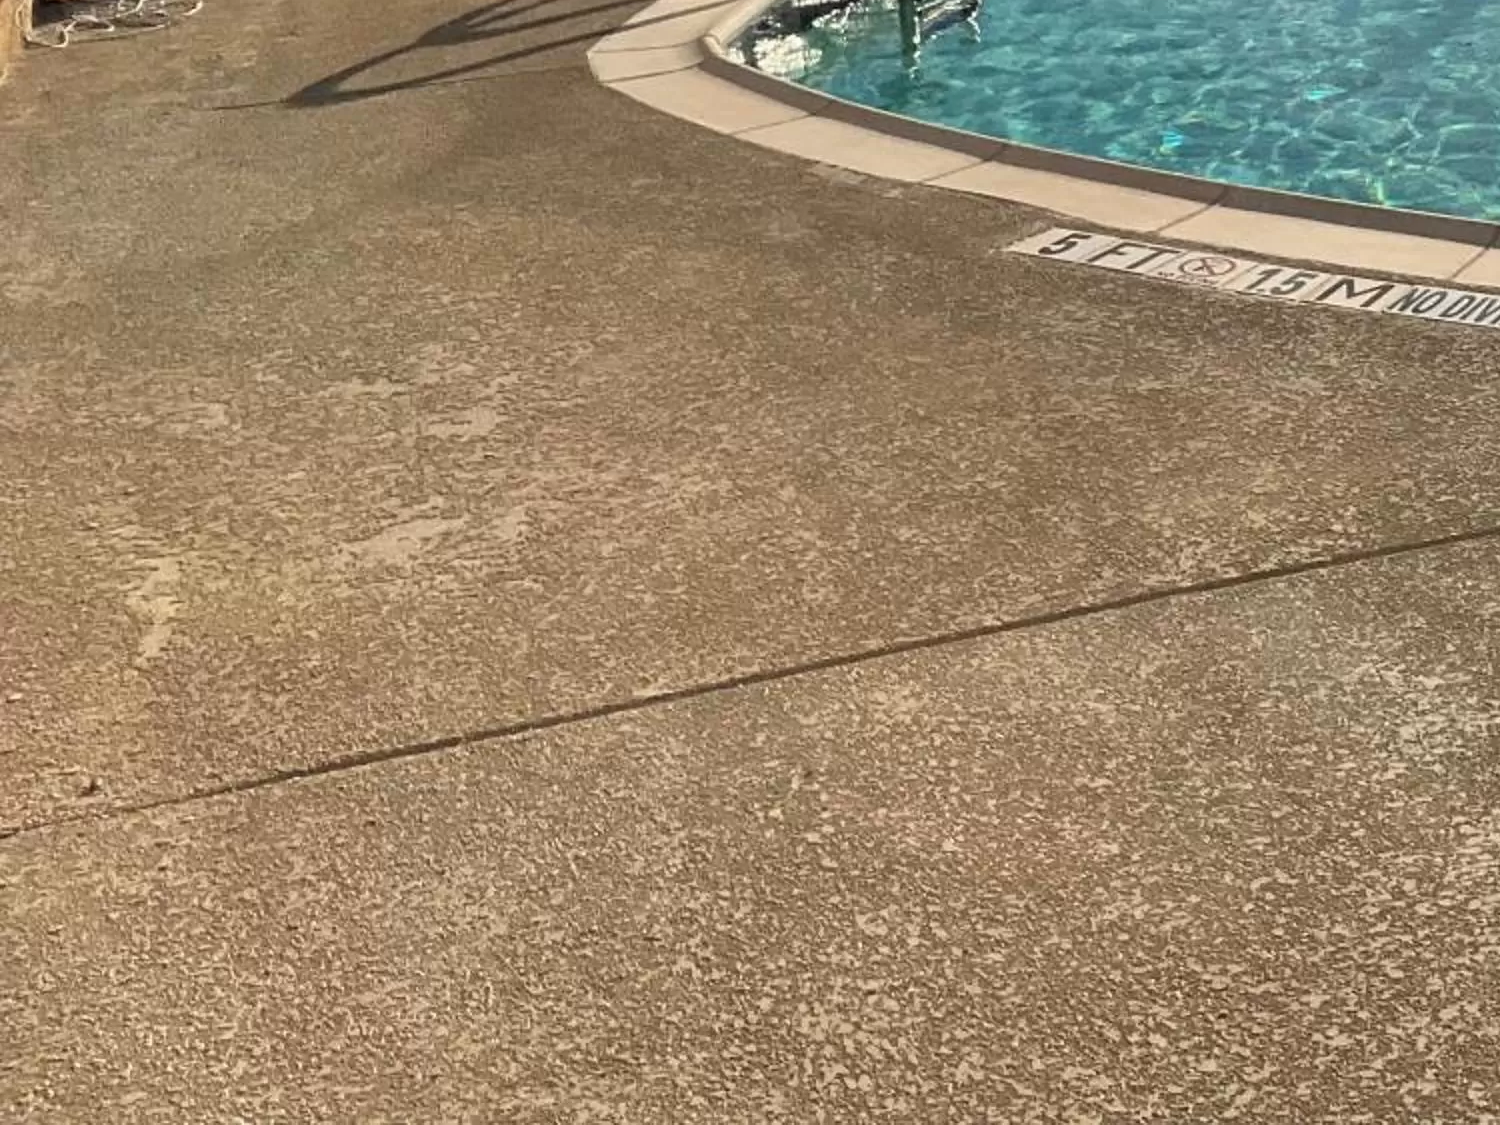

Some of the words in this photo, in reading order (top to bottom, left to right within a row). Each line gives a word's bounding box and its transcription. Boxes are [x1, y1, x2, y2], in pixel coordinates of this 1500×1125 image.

[1038, 233, 1092, 255] 5
[1088, 242, 1182, 270] FT
[1316, 278, 1396, 308] M
[1388, 287, 1450, 314] NO
